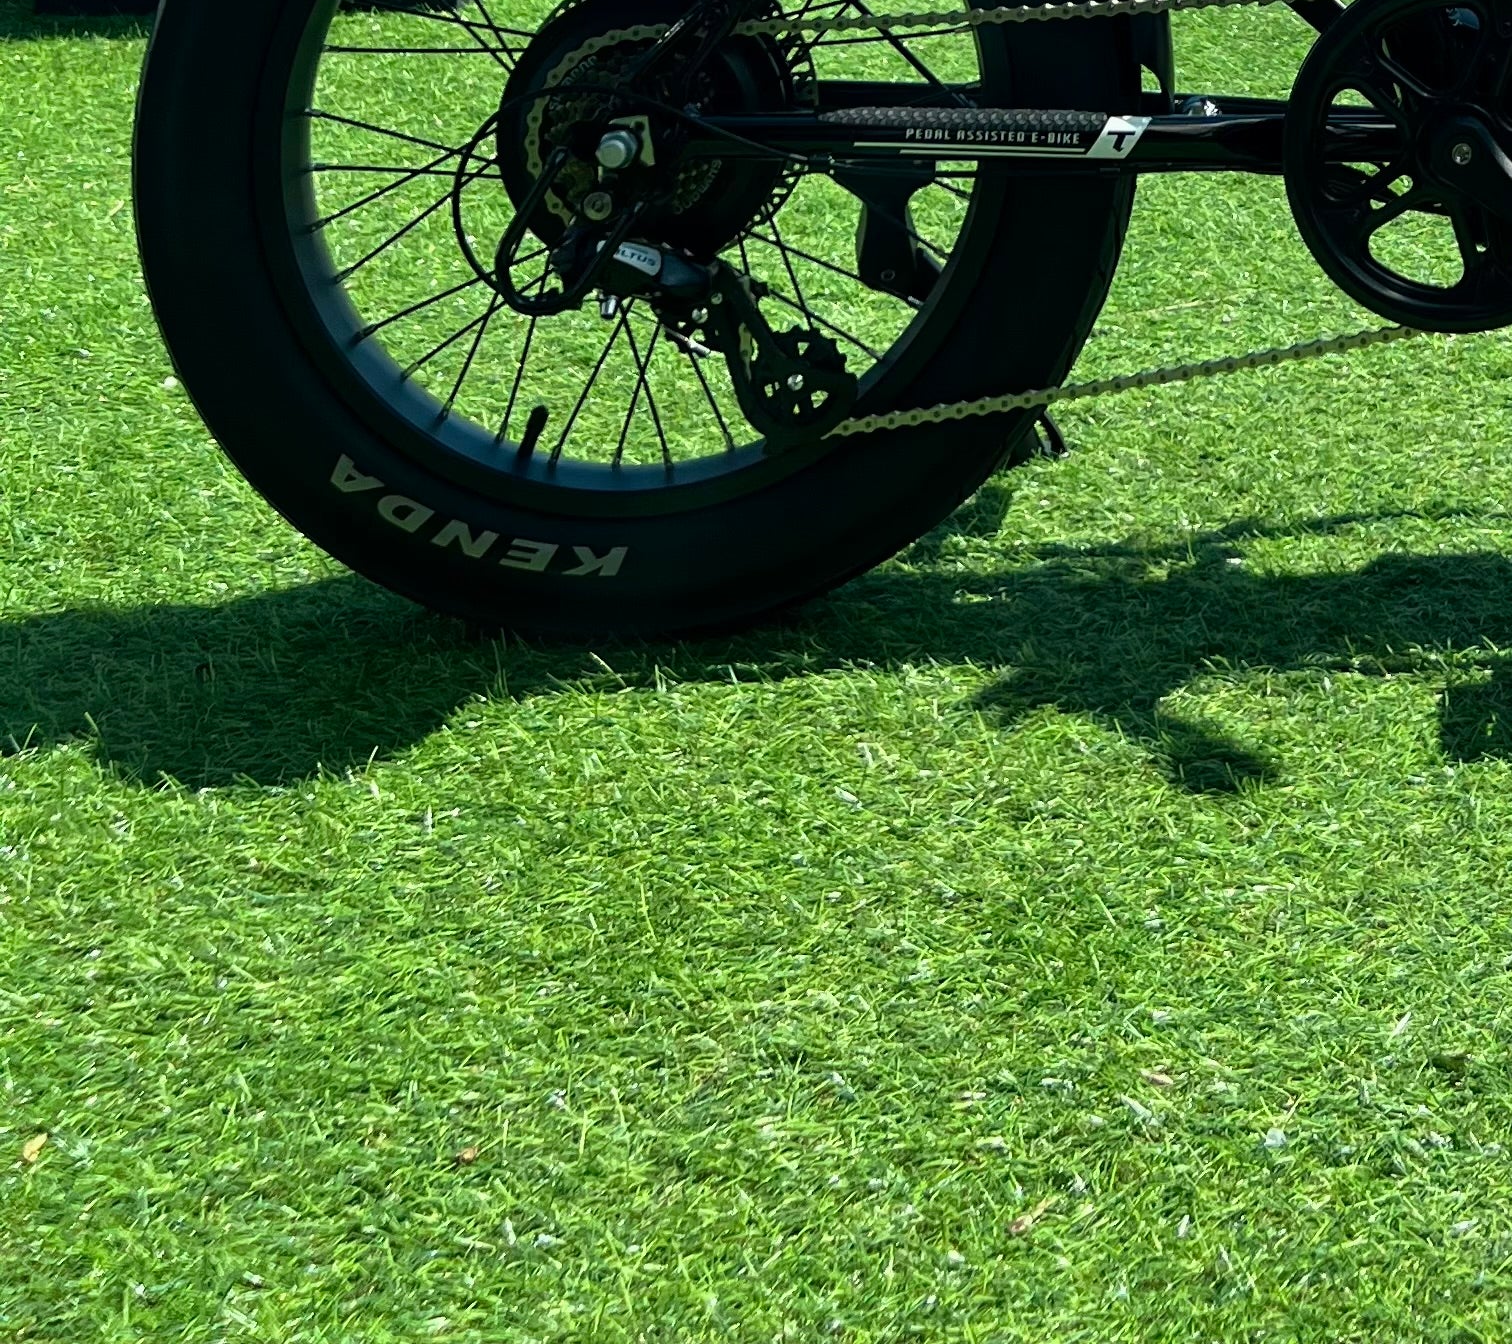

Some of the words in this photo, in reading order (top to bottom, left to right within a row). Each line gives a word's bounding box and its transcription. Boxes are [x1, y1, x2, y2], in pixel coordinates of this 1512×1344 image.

[905, 128, 951, 141] PEDAL
[956, 129, 1025, 143] ASSISTED
[1031, 131, 1080, 145] E-BIKE
[330, 452, 631, 578] KENDA
